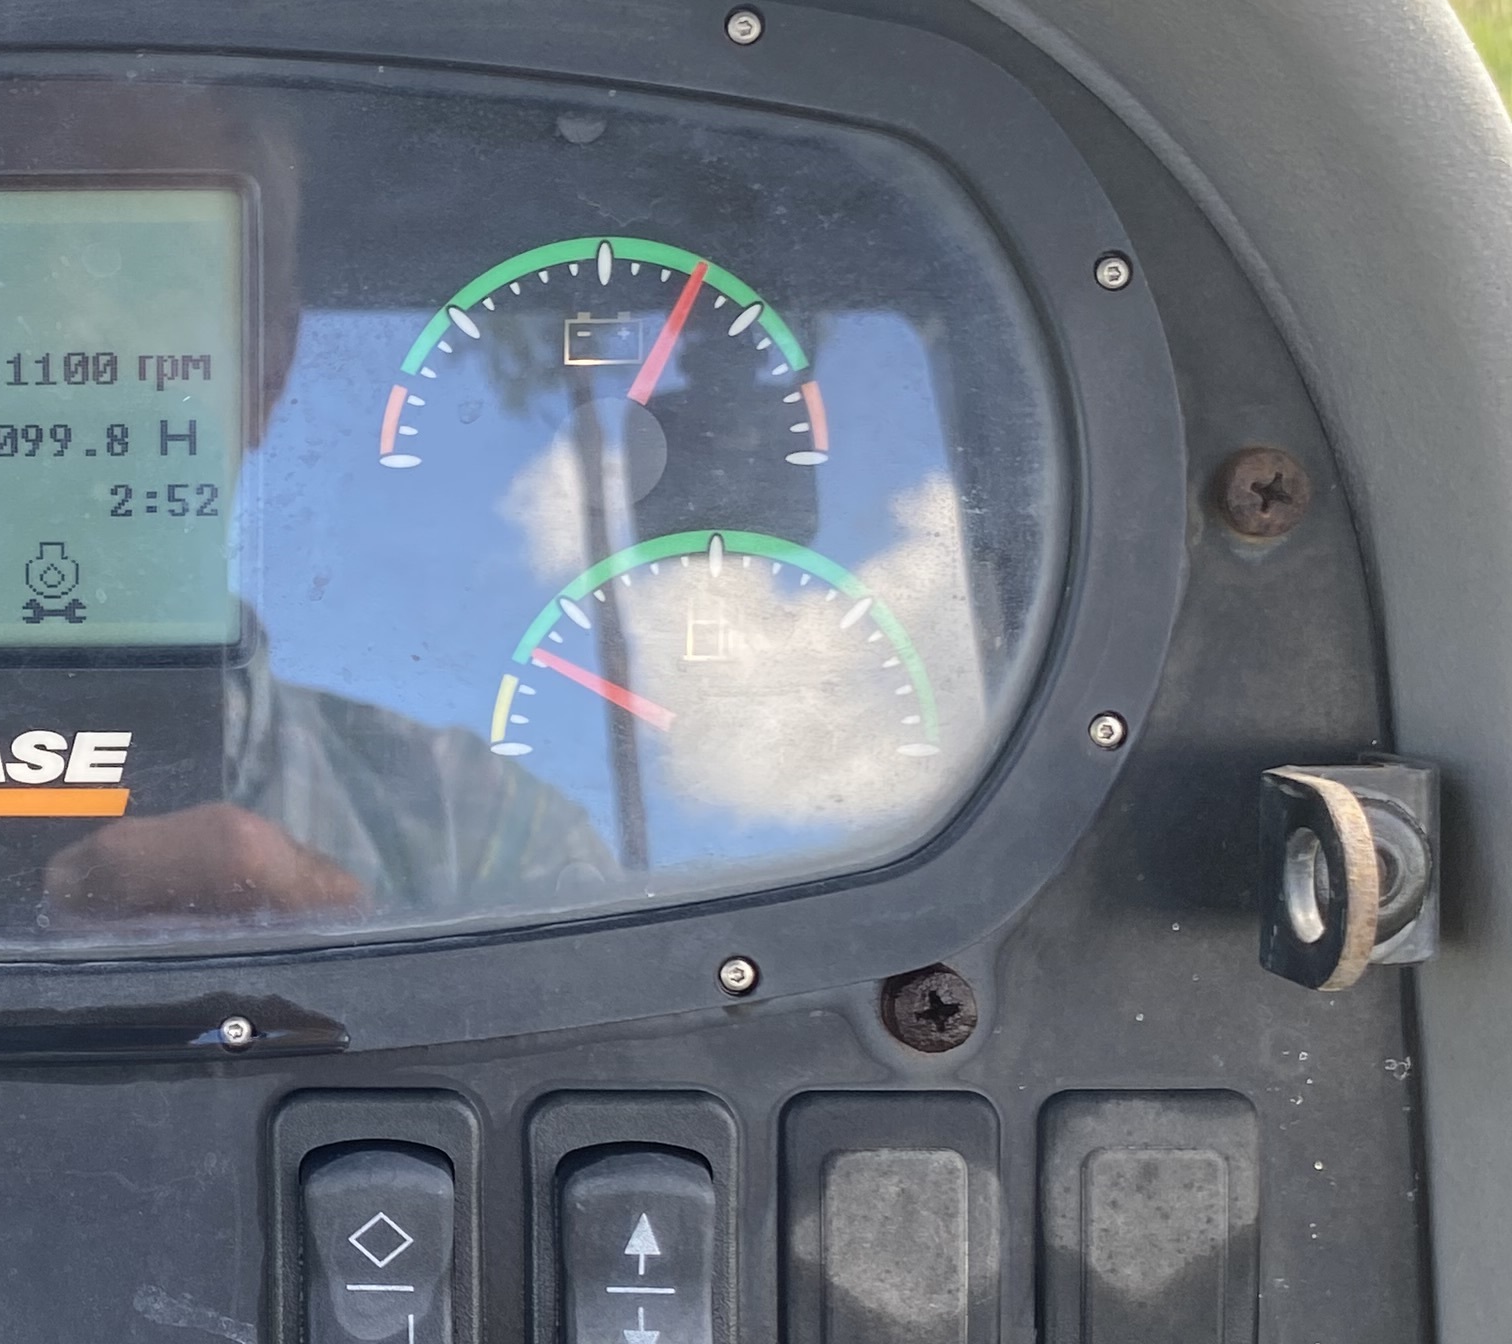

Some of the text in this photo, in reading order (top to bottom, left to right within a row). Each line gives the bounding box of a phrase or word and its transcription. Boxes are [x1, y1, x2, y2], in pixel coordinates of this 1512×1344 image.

[5, 352, 212, 391] 1100 rpm
[159, 419, 197, 456] H
[109, 483, 219, 517] 2:52
